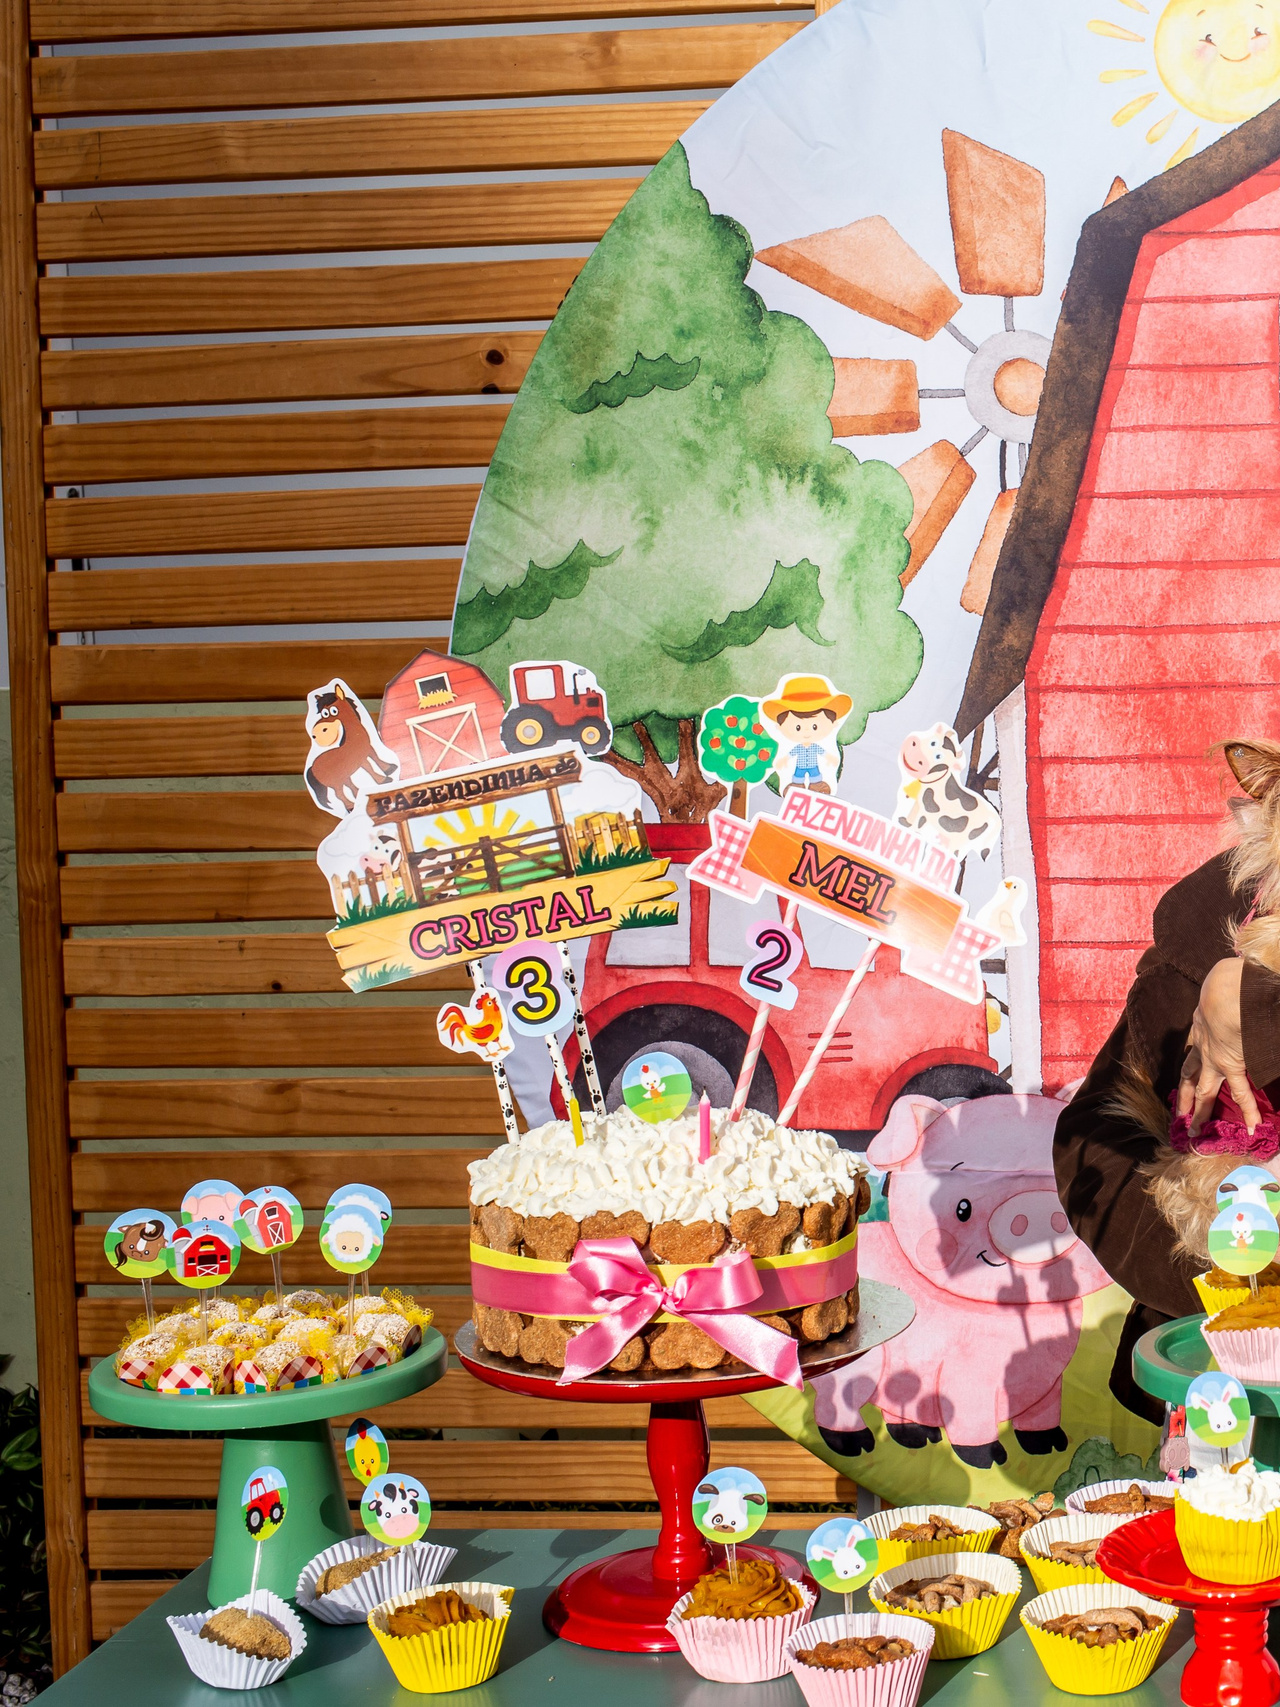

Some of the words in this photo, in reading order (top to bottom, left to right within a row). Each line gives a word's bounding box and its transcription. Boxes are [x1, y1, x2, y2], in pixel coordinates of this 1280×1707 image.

[373, 764, 548, 817] FAZENDINHA
[784, 792, 921, 872] FAZENDINHA
[919, 847, 956, 893] DA
[789, 841, 896, 925] MEL
[410, 886, 612, 960] CRISTAL
[505, 956, 562, 1025] 3
[747, 929, 792, 993] 2
